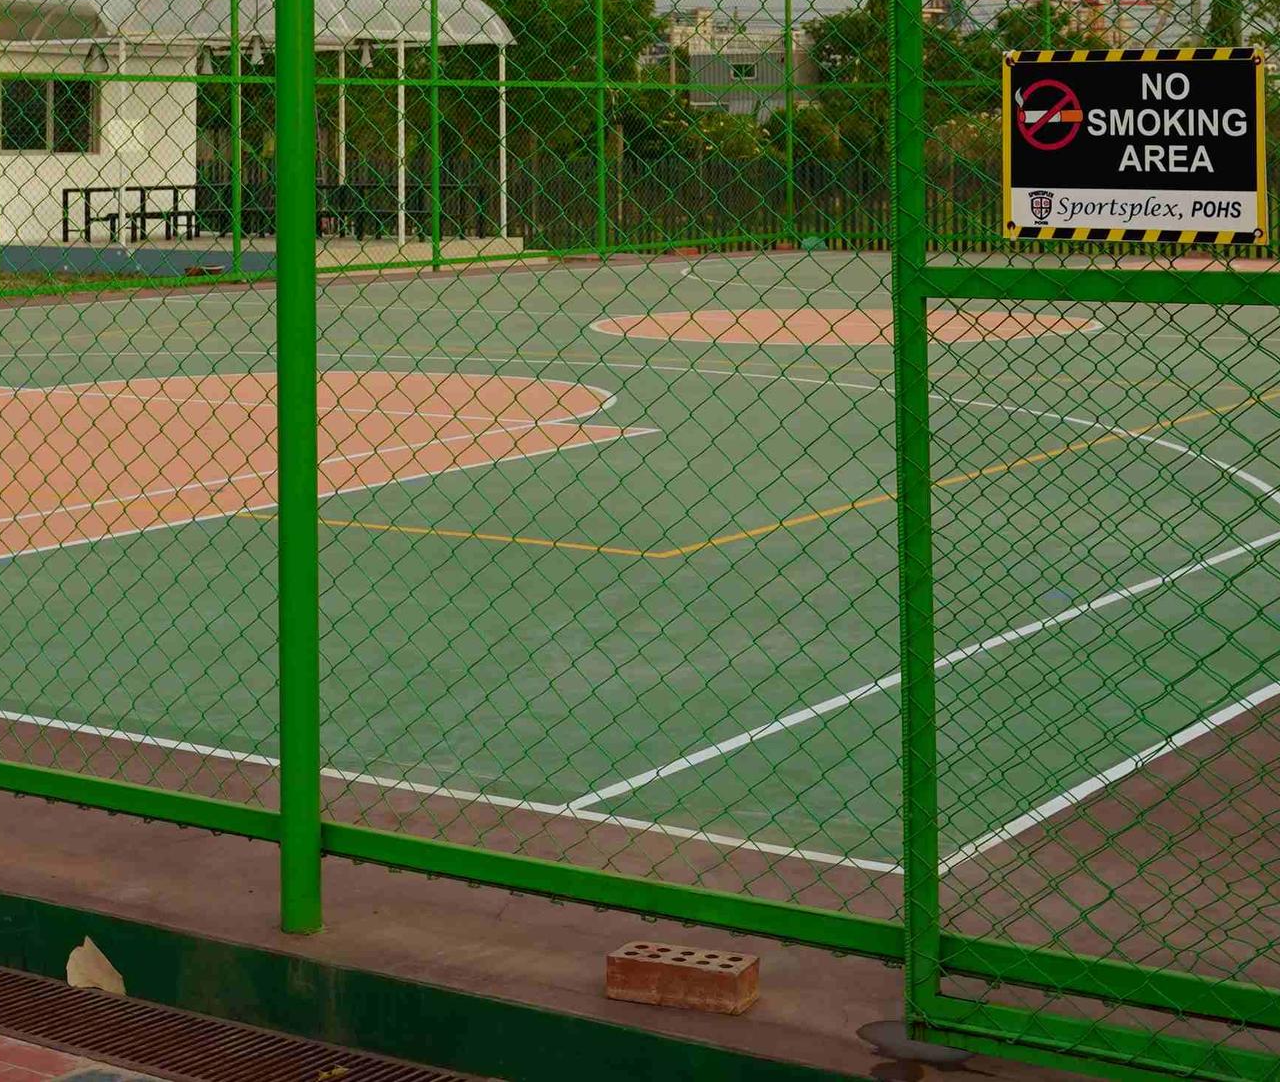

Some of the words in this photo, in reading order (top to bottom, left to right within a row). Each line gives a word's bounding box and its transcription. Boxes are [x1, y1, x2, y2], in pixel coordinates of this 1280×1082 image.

[1141, 72, 1190, 101] NO
[1087, 108, 1248, 137] SMOKING
[1118, 144, 1215, 173] AREA
[1056, 196, 1183, 223] Sportsplex,
[1191, 201, 1242, 219] POHS
